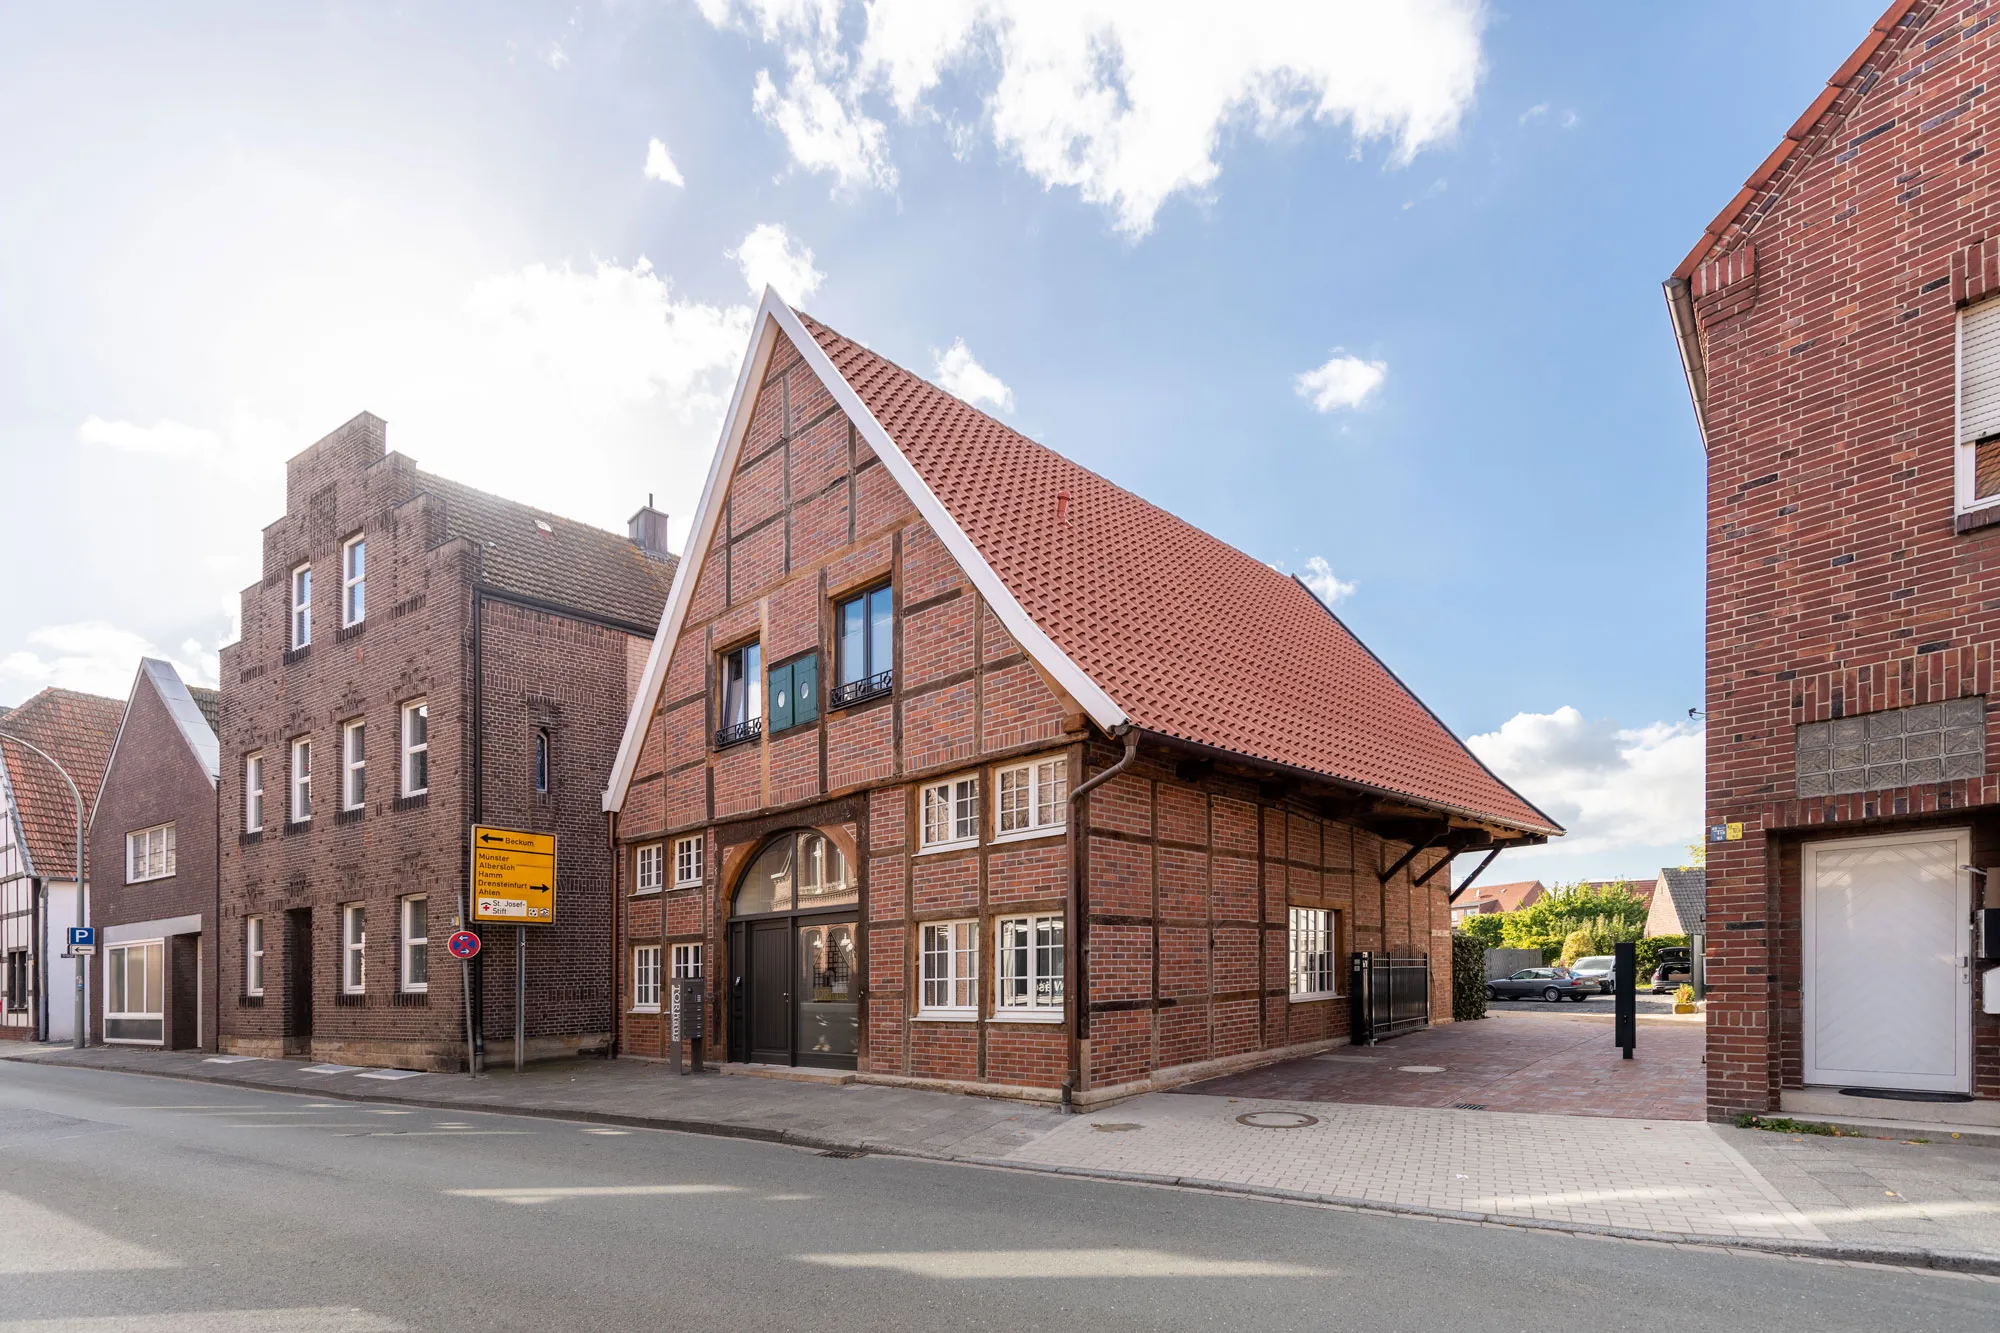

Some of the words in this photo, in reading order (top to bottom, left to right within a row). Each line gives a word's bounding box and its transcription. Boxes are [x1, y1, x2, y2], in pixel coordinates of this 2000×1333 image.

[505, 837, 534, 847] Beckum
[478, 853, 510, 862] Münster
[479, 862, 515, 871] Albersloh
[478, 880, 527, 889] Drensteinfurt
[478, 888, 500, 896] Ahlen
[492, 907, 507, 915] Stift
[75, 929, 89, 943] P
